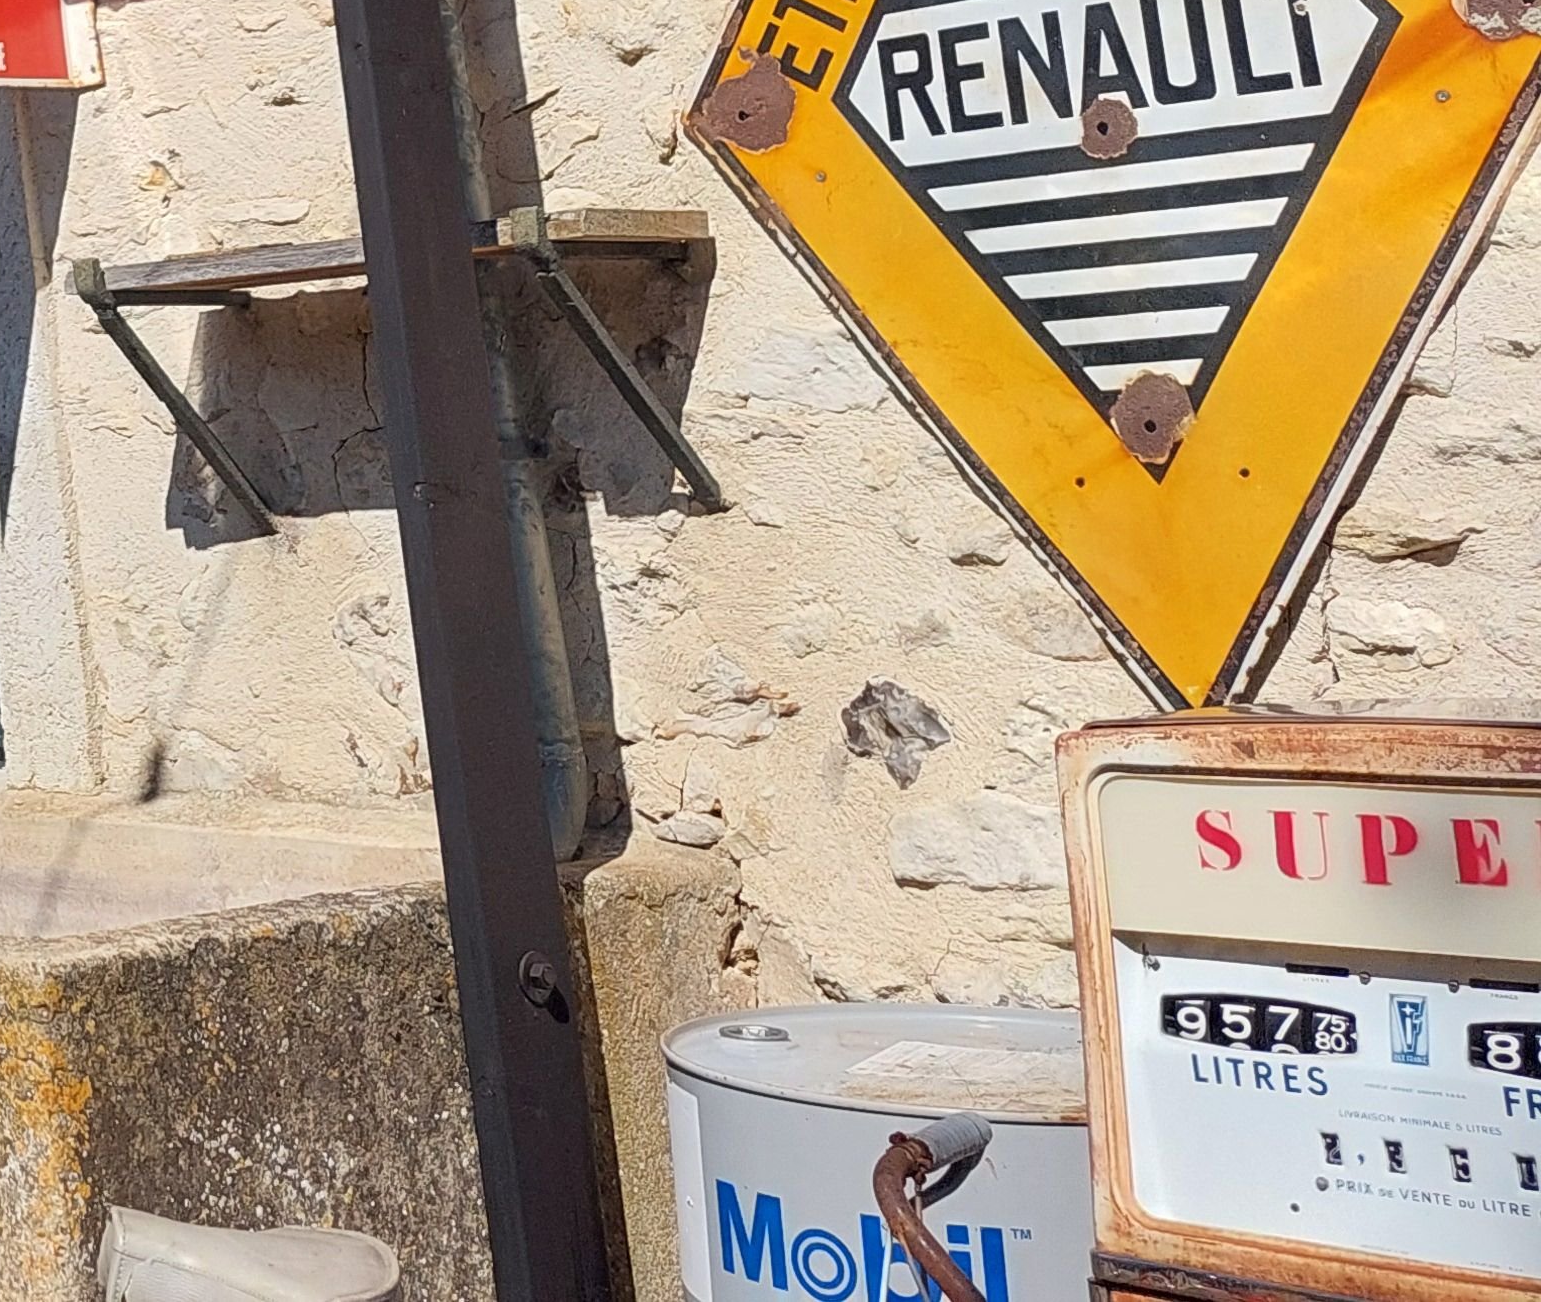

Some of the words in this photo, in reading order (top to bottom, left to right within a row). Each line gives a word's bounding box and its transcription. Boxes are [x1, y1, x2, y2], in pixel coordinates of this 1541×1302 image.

[1195, 808, 1541, 886] SUPE
[1191, 1053, 1329, 1096] LITRES
[1338, 1108, 1395, 1123] LIVRAISON
[1399, 1115, 1451, 1131] MINIMALE
[1466, 1123, 1503, 1137] LITRES
[1336, 1178, 1373, 1195] PRIX
[1399, 1188, 1452, 1207] VENTE
[1482, 1198, 1532, 1217] LITRE
[716, 1179, 1008, 1302] Mobil
[1011, 1228, 1032, 1240] TM
